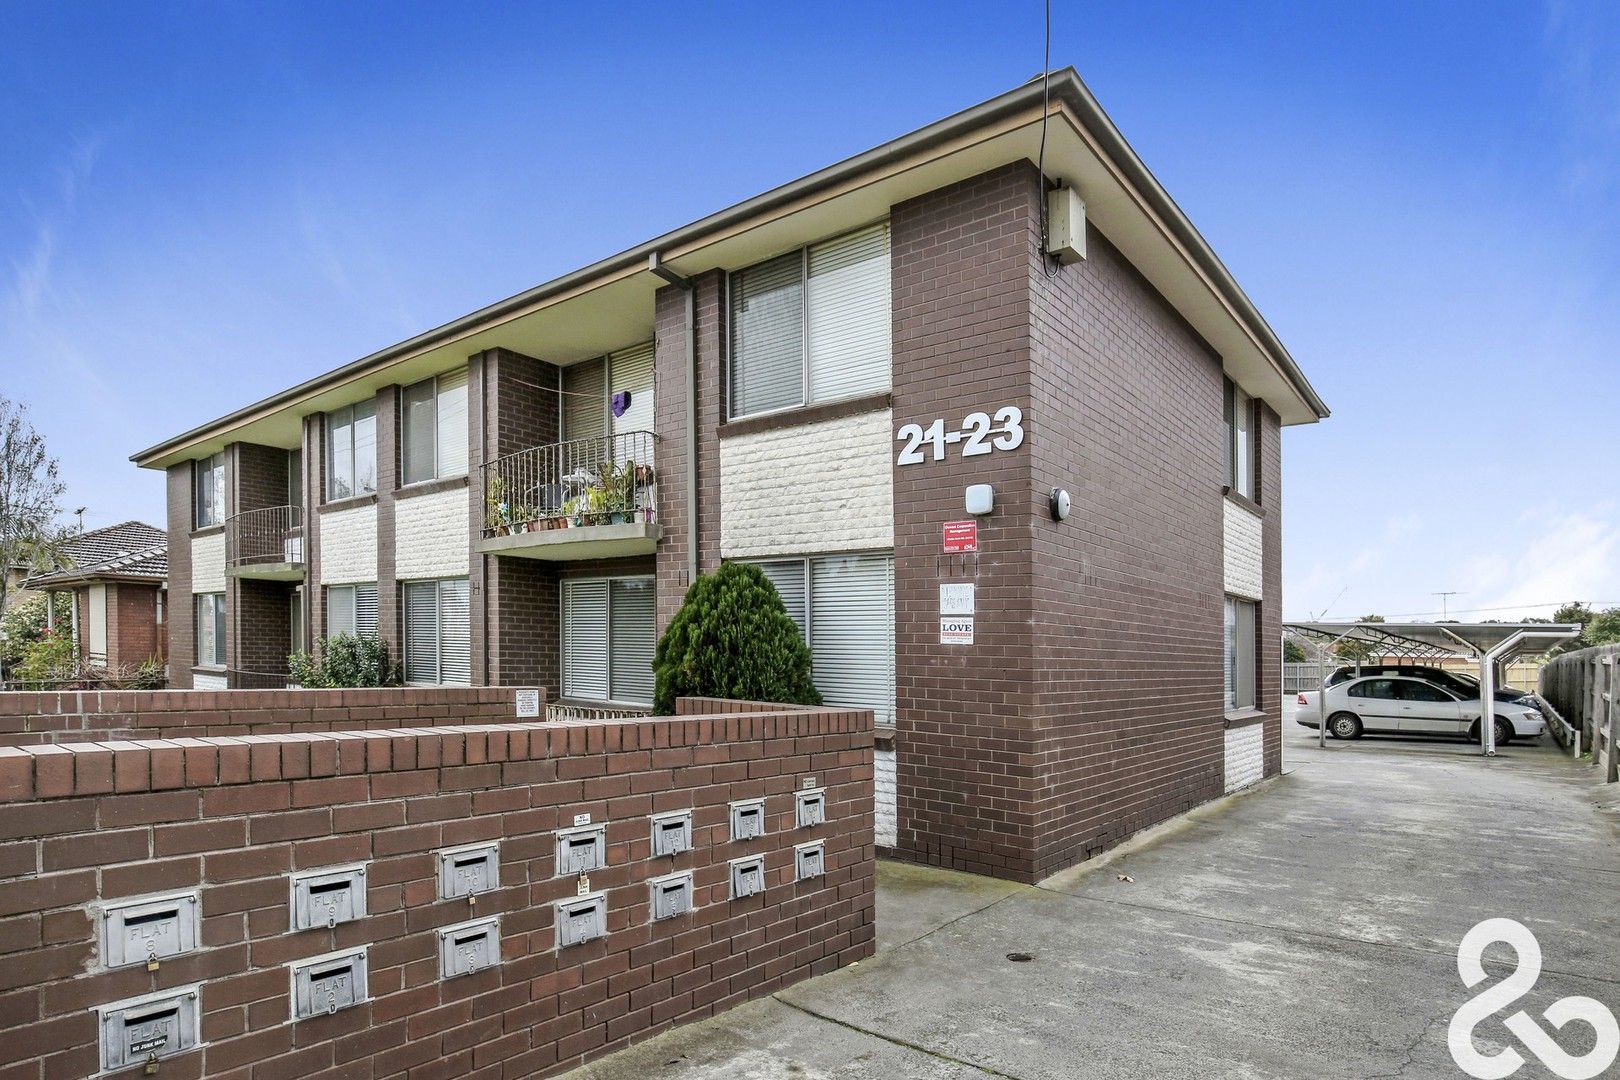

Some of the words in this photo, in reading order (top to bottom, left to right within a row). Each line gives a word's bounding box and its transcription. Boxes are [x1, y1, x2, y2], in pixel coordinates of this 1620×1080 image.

[897, 406, 1025, 466] 21-23
[942, 623, 972, 632] LOVE
[571, 846, 592, 858] FLAT
[457, 866, 482, 879] FLAT
[313, 891, 347, 908] FLAT
[328, 906, 336, 917] 9
[129, 921, 171, 941] FLAT
[145, 940, 154, 952] 8
[458, 941, 483, 957] FLAT
[315, 977, 348, 995] FLAT
[327, 991, 336, 1004] 2
[130, 1019, 172, 1042] FLAT
[131, 1045, 139, 1053] NO
[139, 1041, 154, 1051] JUNK
[154, 1037, 167, 1046] MAIL
